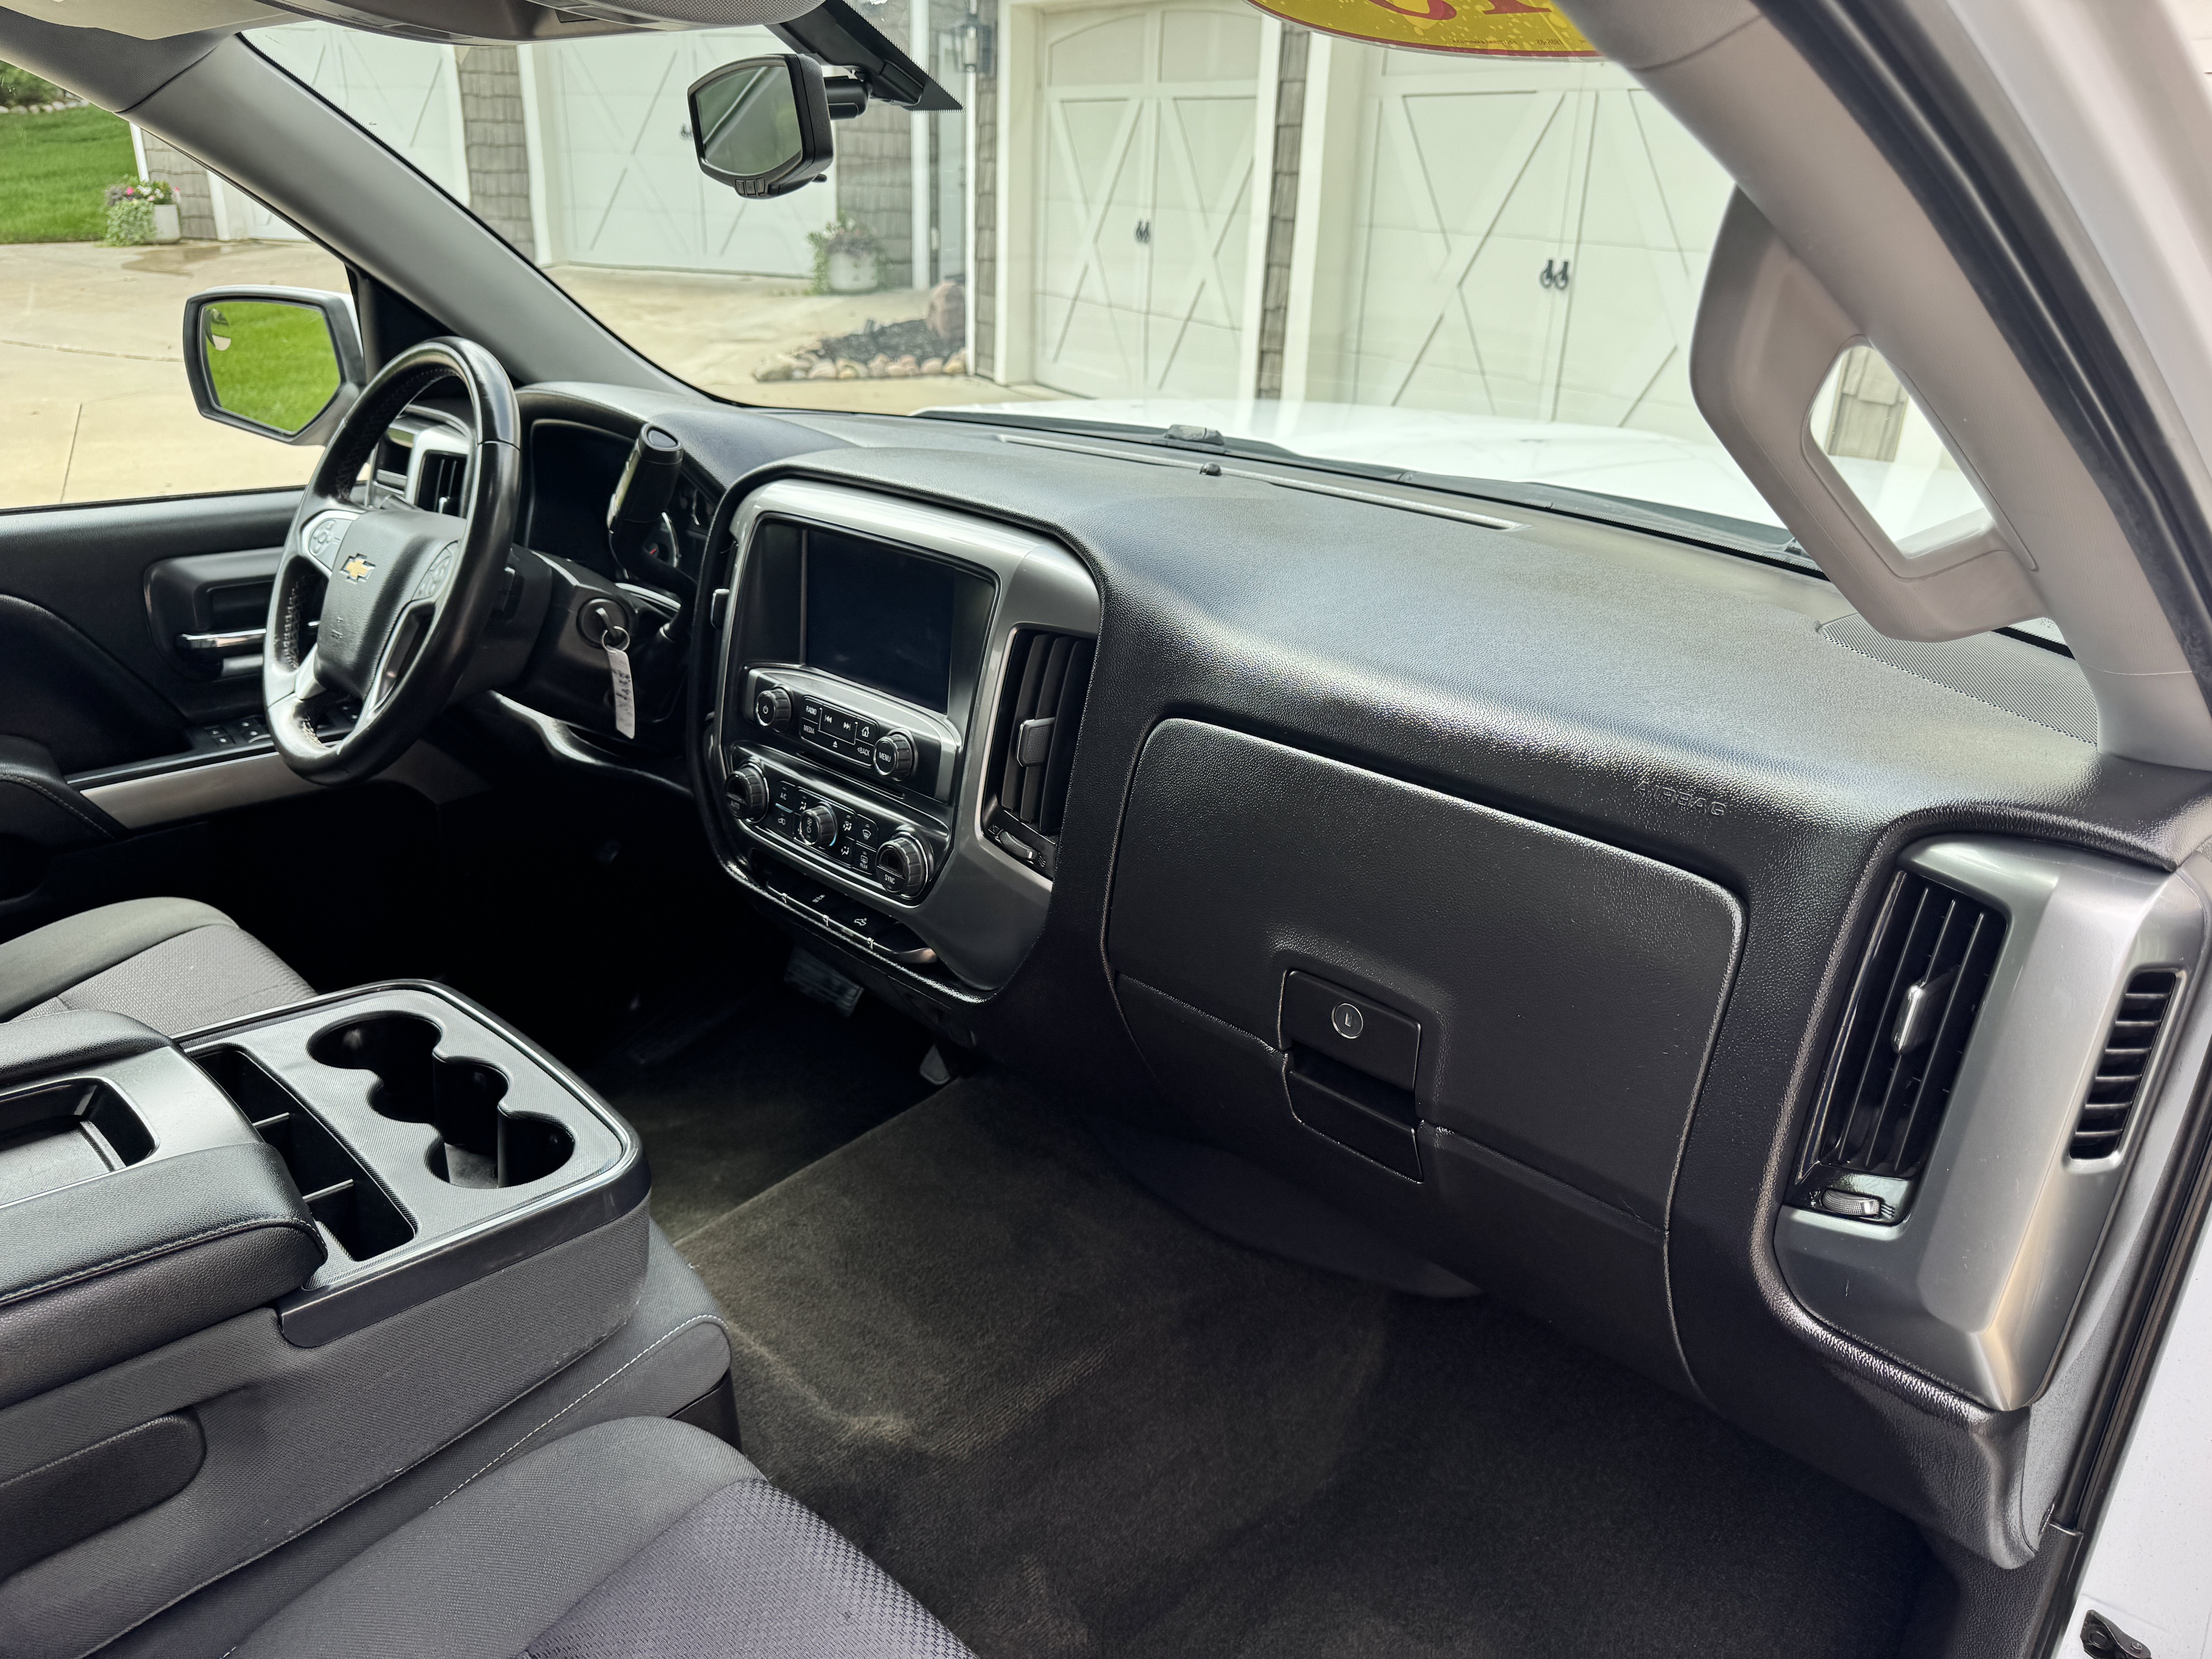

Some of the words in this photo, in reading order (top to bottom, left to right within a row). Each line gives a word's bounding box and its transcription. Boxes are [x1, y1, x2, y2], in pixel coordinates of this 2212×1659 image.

[806, 706, 817, 715] RADIO
[879, 752, 891, 763] MENU
[1633, 780, 1728, 816] AIRBAG
[884, 874, 895, 884] SYNC
